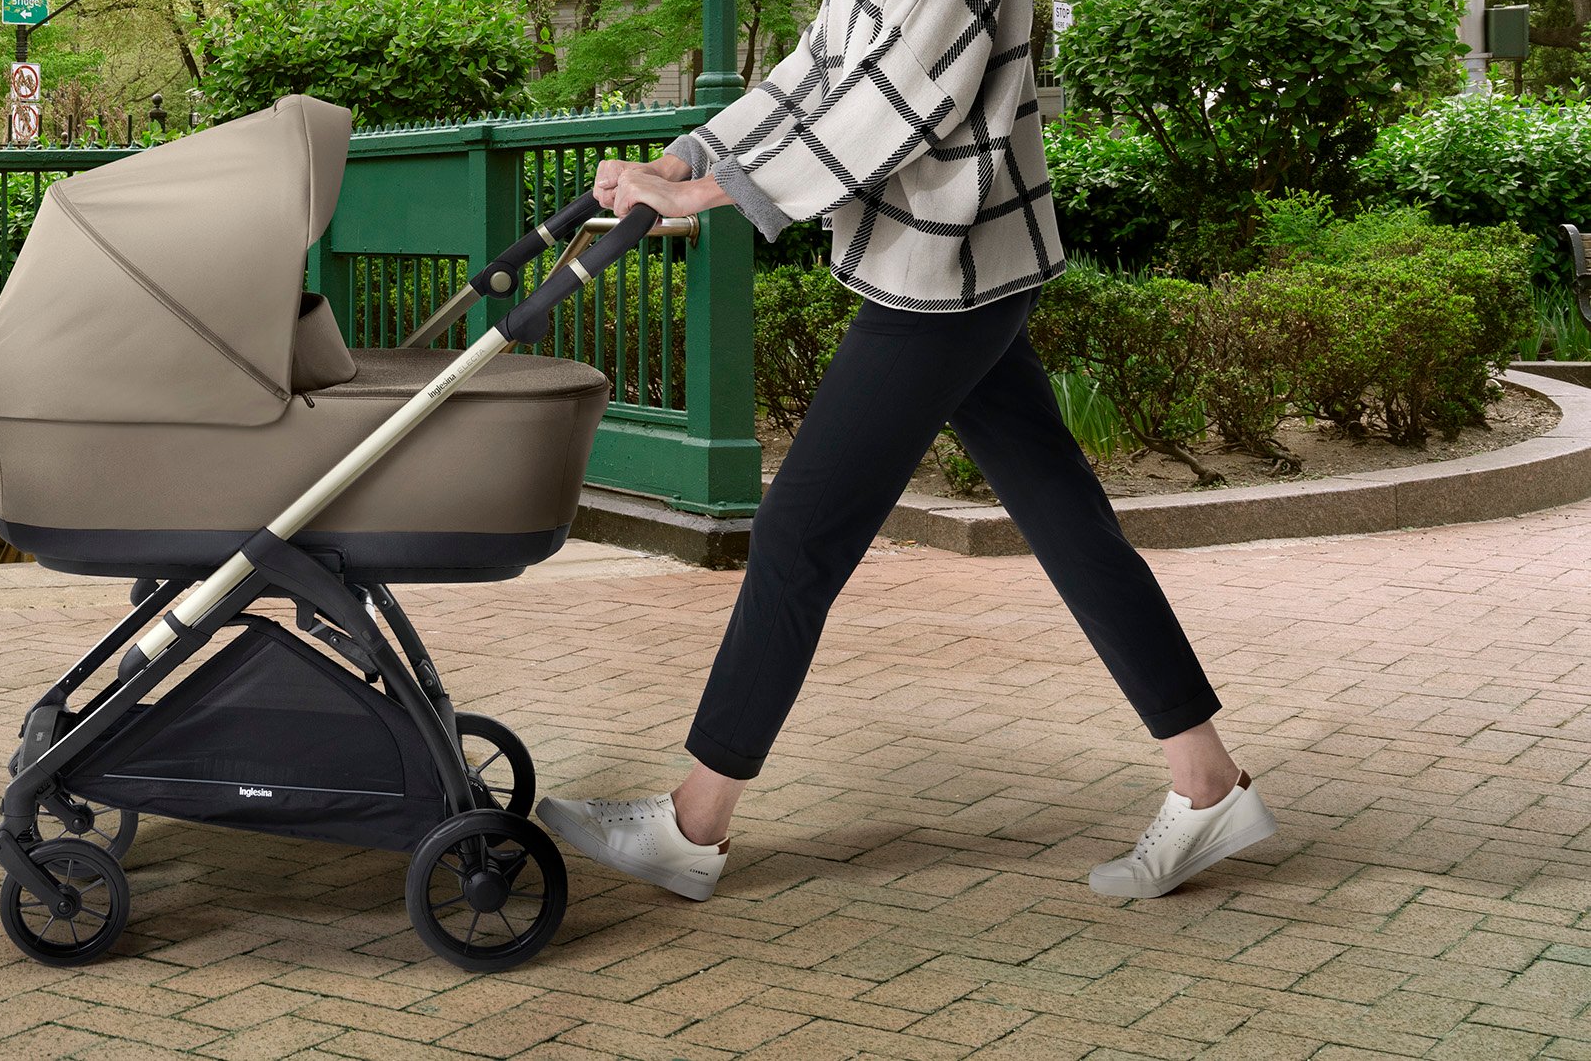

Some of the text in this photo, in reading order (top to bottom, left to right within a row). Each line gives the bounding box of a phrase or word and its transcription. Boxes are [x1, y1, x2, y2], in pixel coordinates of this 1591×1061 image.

[1055, 7, 1070, 19] STOP
[428, 349, 484, 398] Inglesina ELECTA
[239, 787, 272, 797] Inglesina
